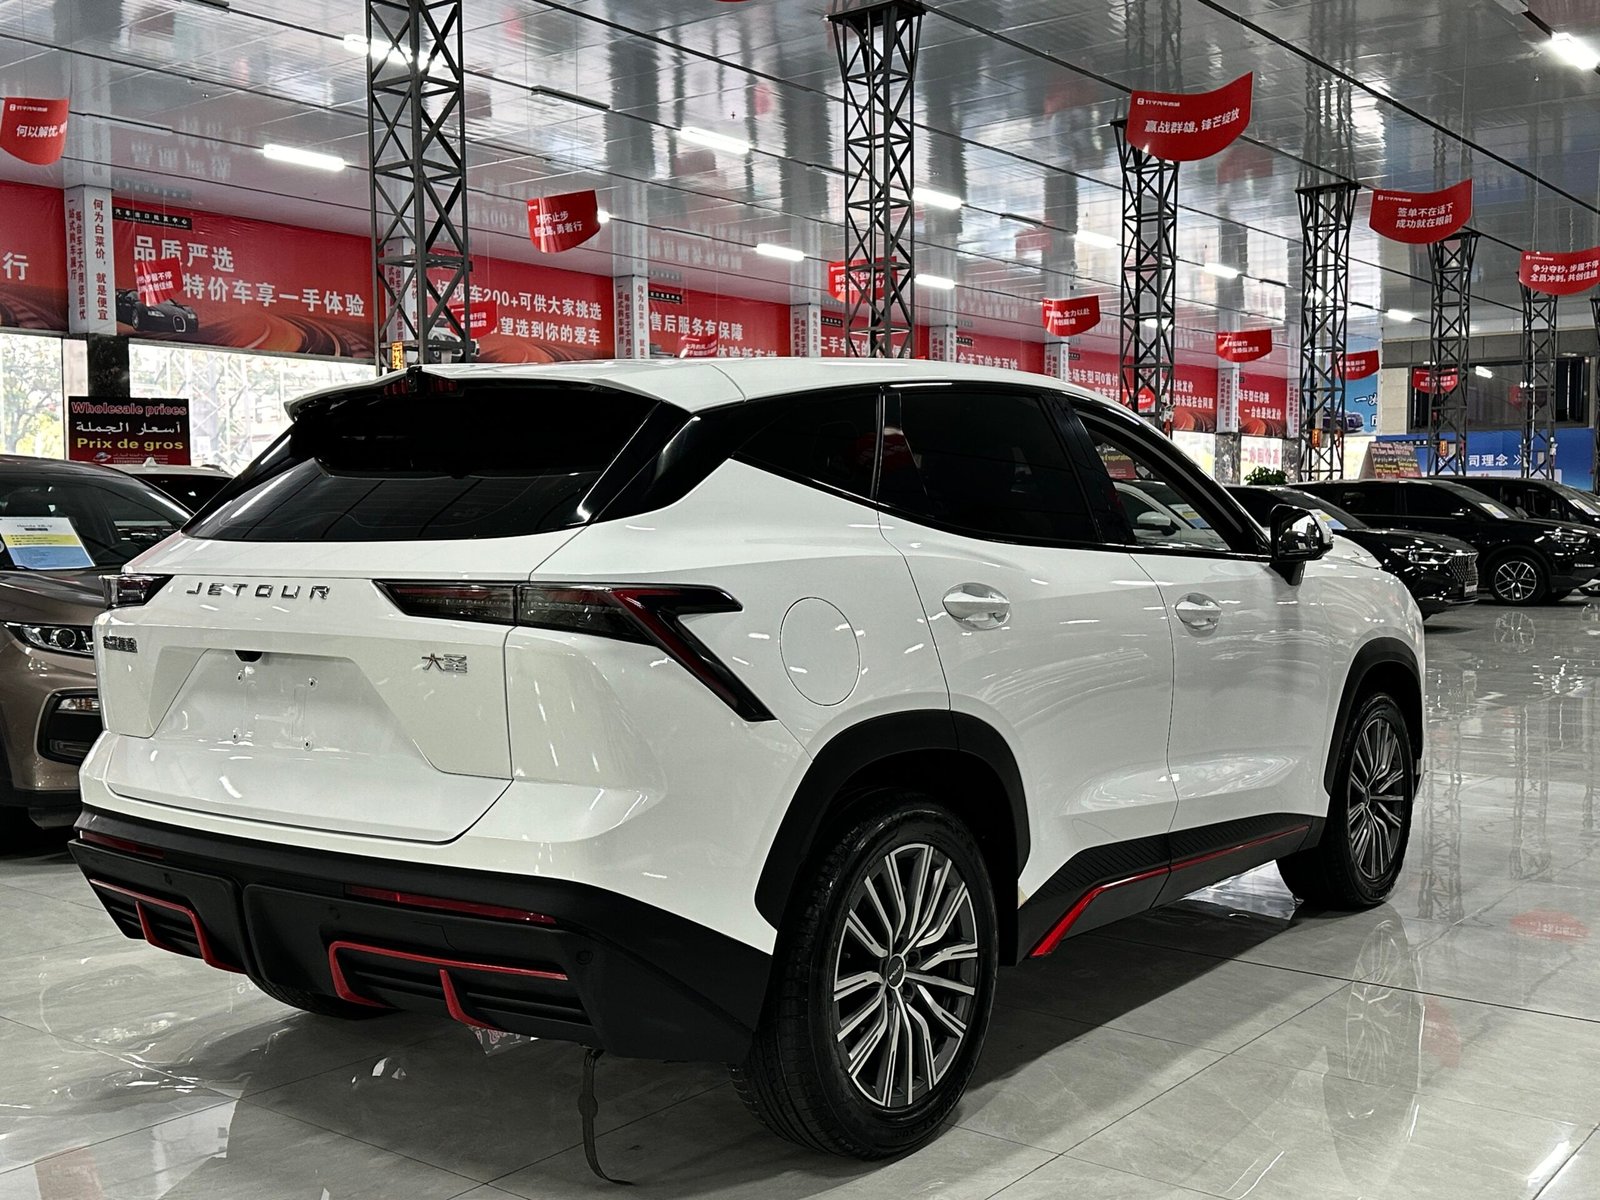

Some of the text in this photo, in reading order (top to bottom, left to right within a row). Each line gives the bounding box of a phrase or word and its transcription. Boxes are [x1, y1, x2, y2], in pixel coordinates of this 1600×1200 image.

[1397, 202, 1454, 218] 签单不在话下
[1395, 214, 1453, 229] 成功就在眼前
[134, 235, 235, 273] 品质严选
[3, 252, 29, 281] 行
[182, 272, 365, 317] 特价车享一手体验
[650, 311, 743, 341] 售后服务有保障
[71, 401, 187, 417] Wholesale prices
[76, 421, 181, 435] أسعار الجملة
[77, 438, 184, 452] Prix de gros
[186, 582, 330, 600] JETOUR
